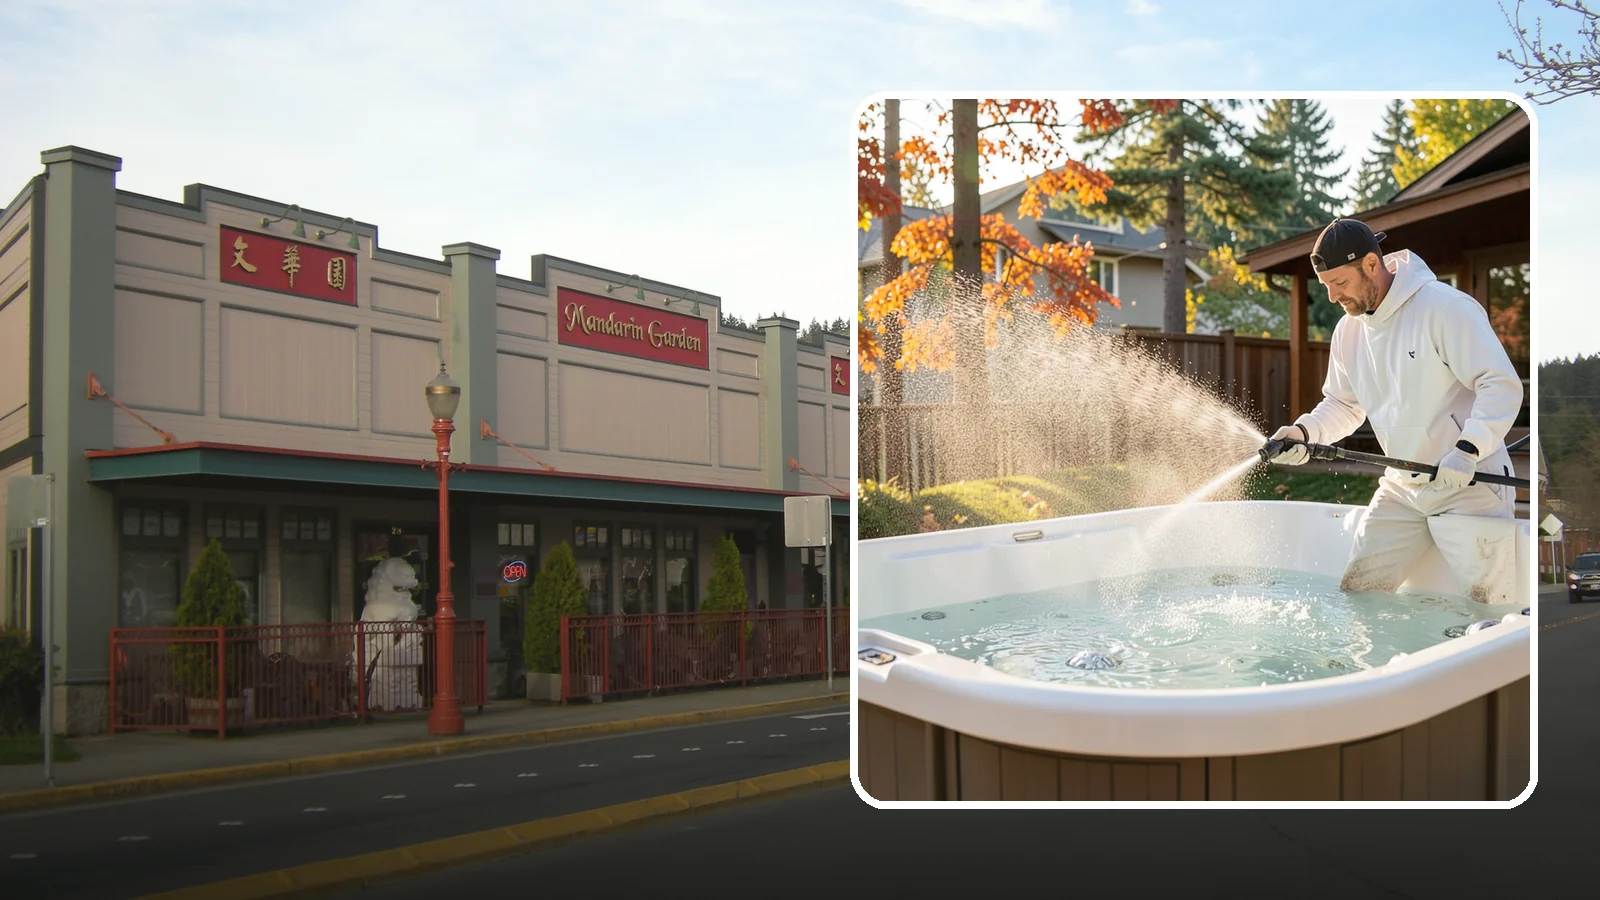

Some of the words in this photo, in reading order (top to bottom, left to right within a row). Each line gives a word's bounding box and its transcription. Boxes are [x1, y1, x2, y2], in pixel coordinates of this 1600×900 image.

[231, 235, 346, 291] 文華園
[564, 302, 644, 341] Mandarin
[648, 320, 701, 352] Garden
[503, 565, 527, 578] OPEN
